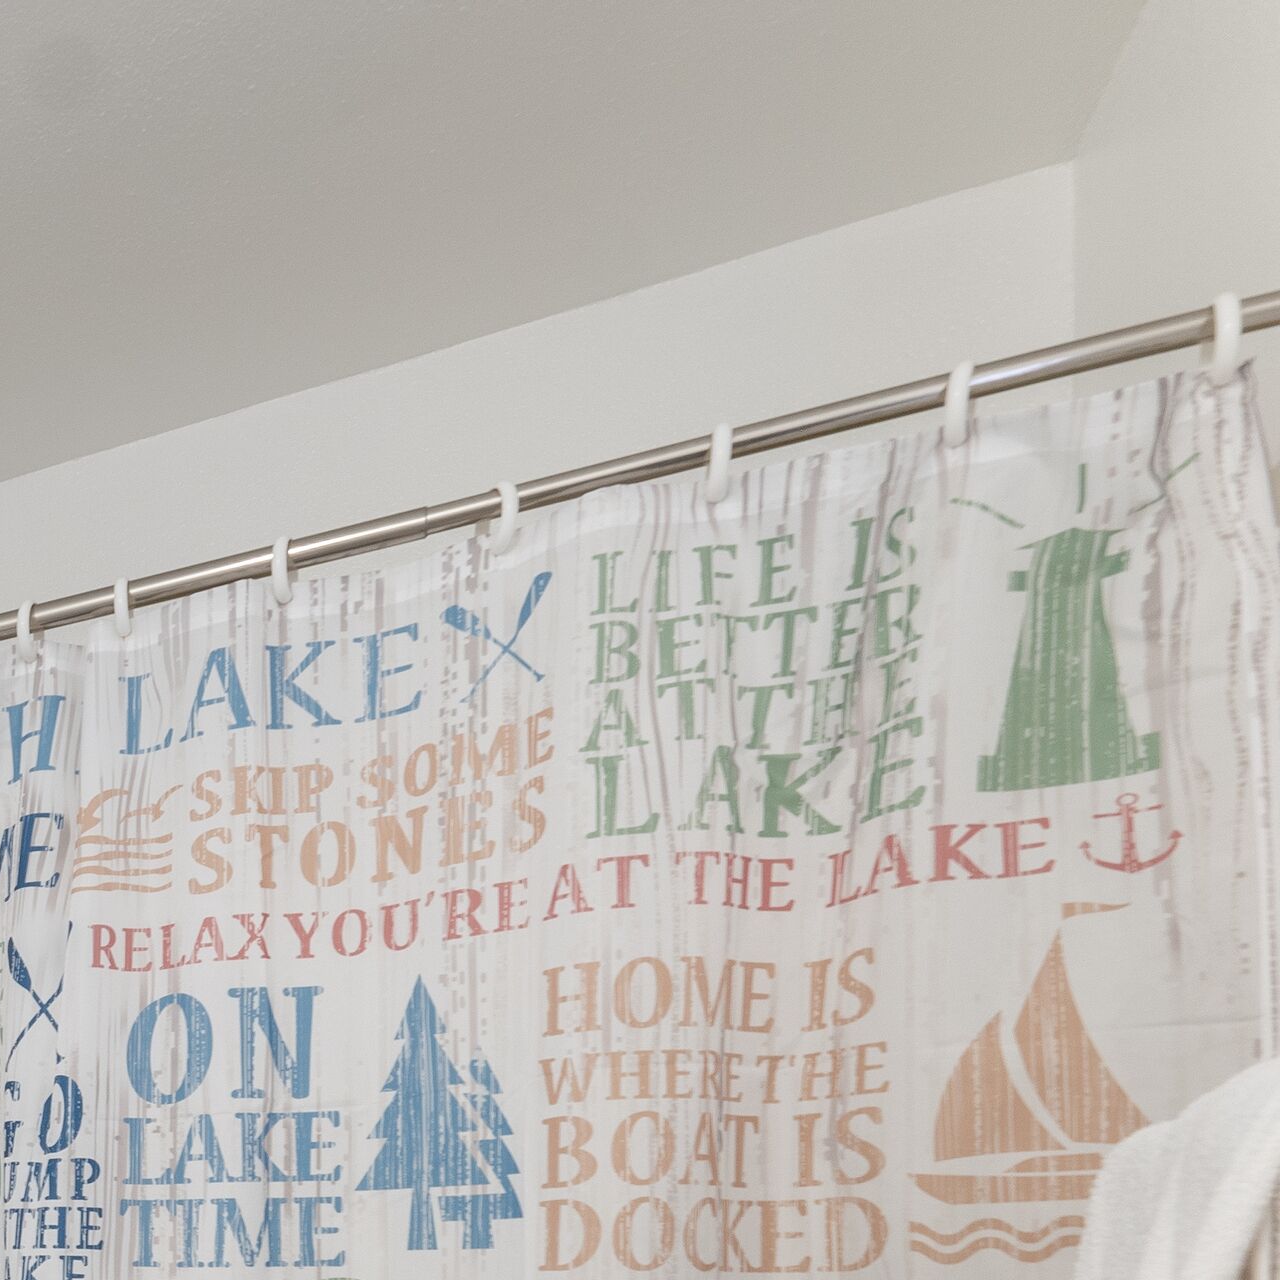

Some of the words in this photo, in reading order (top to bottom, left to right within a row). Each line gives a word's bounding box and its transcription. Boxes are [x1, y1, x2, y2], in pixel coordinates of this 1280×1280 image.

[588, 534, 798, 617] LIFE
[843, 506, 917, 592] IS
[588, 583, 924, 686] BETTER
[117, 622, 428, 756] LAKE
[579, 678, 715, 753] AT
[735, 647, 919, 751] THE
[188, 763, 335, 822] SKIP
[356, 706, 555, 810] SOME
[584, 716, 927, 839] LAKE
[187, 777, 546, 895] STONES
[89, 912, 282, 974] RELAX
[281, 876, 532, 960] YOU'RE
[542, 853, 651, 923] AT
[674, 849, 797, 913] THE
[825, 816, 1057, 909] LAKE
[541, 954, 776, 1037] HOME
[800, 946, 877, 1033] IS
[125, 984, 326, 1106] ON
[538, 1048, 743, 1107] WHERE
[756, 1041, 892, 1104] THE
[122, 1108, 342, 1186] LAKE
[541, 1110, 760, 1189] BOAT
[791, 1105, 887, 1189] IS
[120, 1195, 347, 1269] TIME
[538, 1195, 889, 1274] DOCKED
